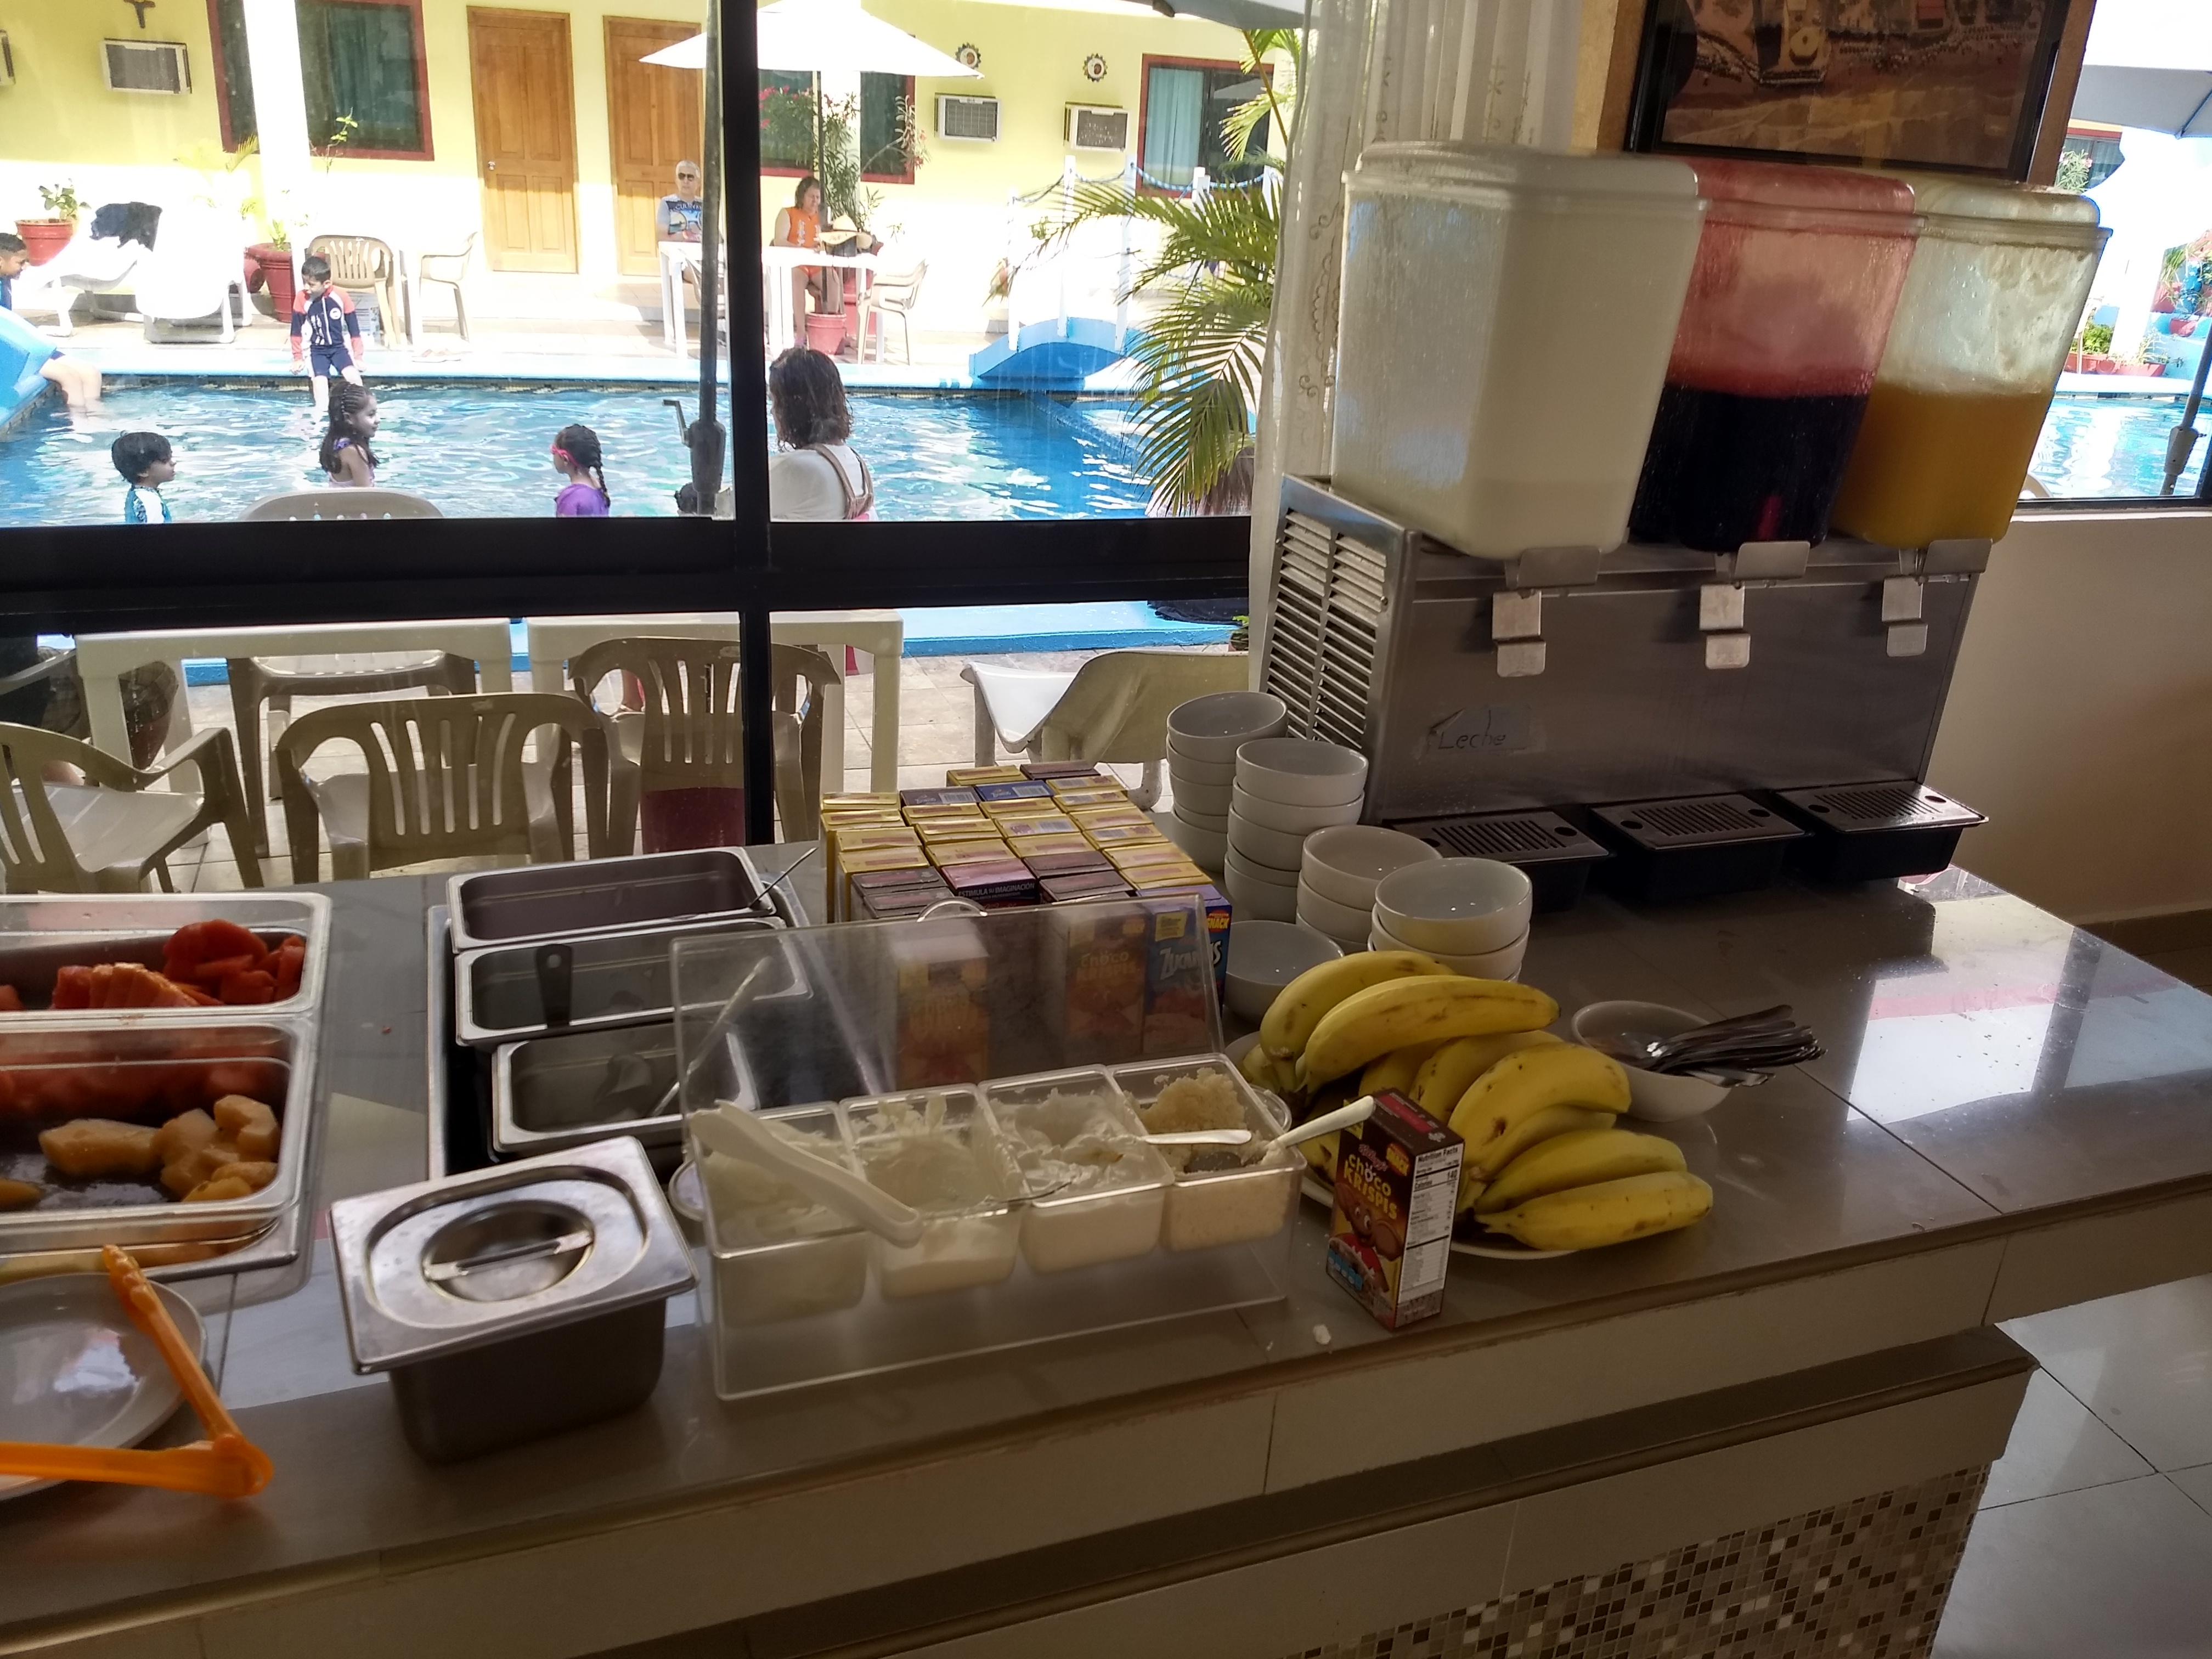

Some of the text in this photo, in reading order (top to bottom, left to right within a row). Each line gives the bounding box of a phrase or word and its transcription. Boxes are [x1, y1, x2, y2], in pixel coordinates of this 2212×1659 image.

[1438, 710, 1506, 749] Leche
[958, 888, 988, 897] ESTIMULA
[995, 882, 1035, 894] IMAGINACIÓN
[1206, 918, 1229, 929] SNACK
[1418, 1152, 1442, 1162] Nutrition
[1443, 1147, 1458, 1156] Facts
